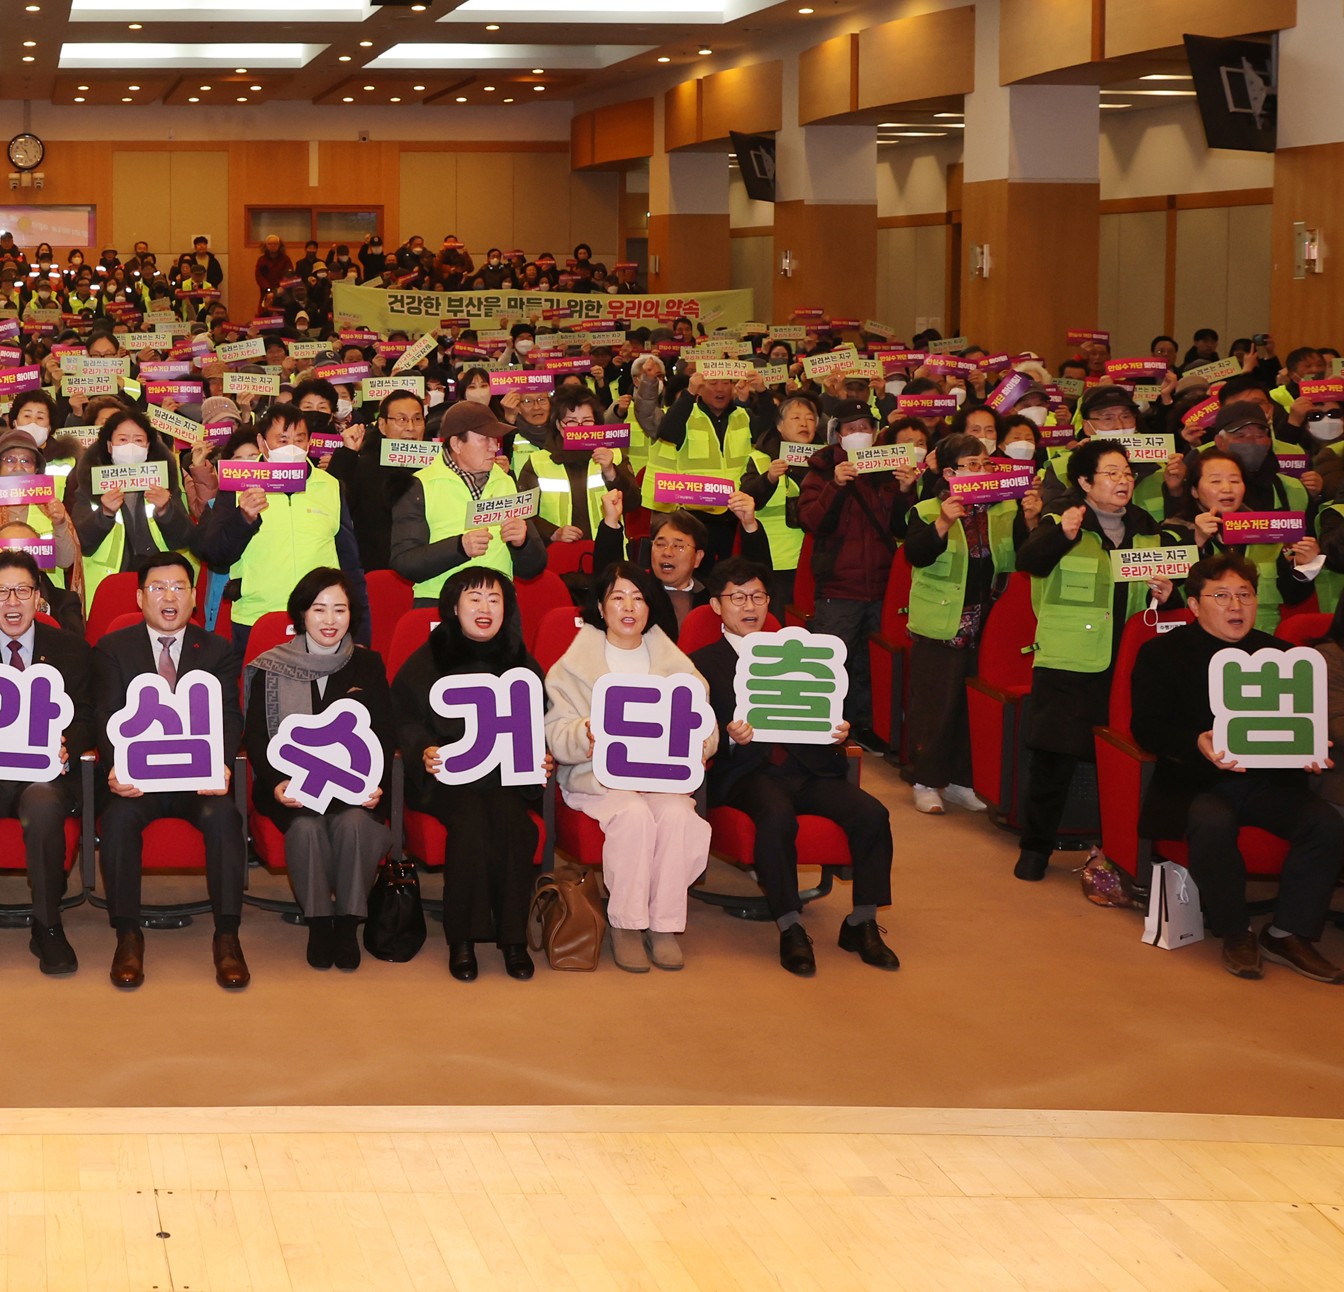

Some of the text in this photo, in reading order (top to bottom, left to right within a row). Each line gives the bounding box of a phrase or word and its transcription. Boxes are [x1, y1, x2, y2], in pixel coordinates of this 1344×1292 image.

[388, 294, 441, 316] 건강한
[447, 295, 501, 317] 부산을
[570, 297, 601, 318] 위한
[607, 299, 658, 318] 우리의
[666, 300, 699, 318] 약속
[222, 343, 244, 353] 빌려쓰는
[703, 361, 732, 369] 빌려쓰는
[810, 352, 851, 366] 빌려쓰는 지구
[864, 361, 876, 369] 지구
[318, 366, 368, 378] 안심수거단 화이팅!
[1108, 362, 1142, 372] 안심수거단
[17, 371, 38, 381] 화이팅!
[67, 377, 94, 385] 빌려쓰는
[230, 375, 257, 383] 빌려쓰는
[492, 375, 552, 385] 안심수거단 화이팅!
[400, 378, 416, 387] 지구
[148, 385, 179, 394] 안심수거단
[1301, 384, 1343, 394] 안심수거단
[900, 399, 955, 408] 안심수거단 화이팅!
[154, 409, 198, 432] 빌려쓰는 지구
[210, 427, 232, 435] 화이팅!
[567, 429, 629, 440] 안심수거단 화이팅!
[390, 442, 429, 456] 빌려쓰는
[857, 447, 906, 459] 빌려쓰는 지구
[1134, 449, 1167, 459] 지킨다!
[388, 453, 417, 466] 우리가
[856, 458, 909, 470] 우리가 지킨다!
[101, 465, 158, 478] 빌려쓰는 지구
[222, 469, 304, 480] 안심수거단 화이팅!
[658, 481, 733, 494] 안심수거단 화이팅!
[952, 476, 1029, 493] 안심수거단 화이팅!
[477, 494, 532, 512] 빌려쓰는 지구
[473, 505, 532, 524] 우리가 지킨다!
[1225, 519, 1302, 530] 안심수거단 화이팅!
[1121, 550, 1188, 566] 빌려쓰는 지구
[1121, 564, 1191, 578] 우리가 지킨다!
[746, 639, 836, 732] 출
[1223, 659, 1314, 755] 범
[119, 683, 212, 780] 심
[442, 680, 534, 773] 거
[604, 685, 702, 780] 단
[279, 712, 371, 798] 수
